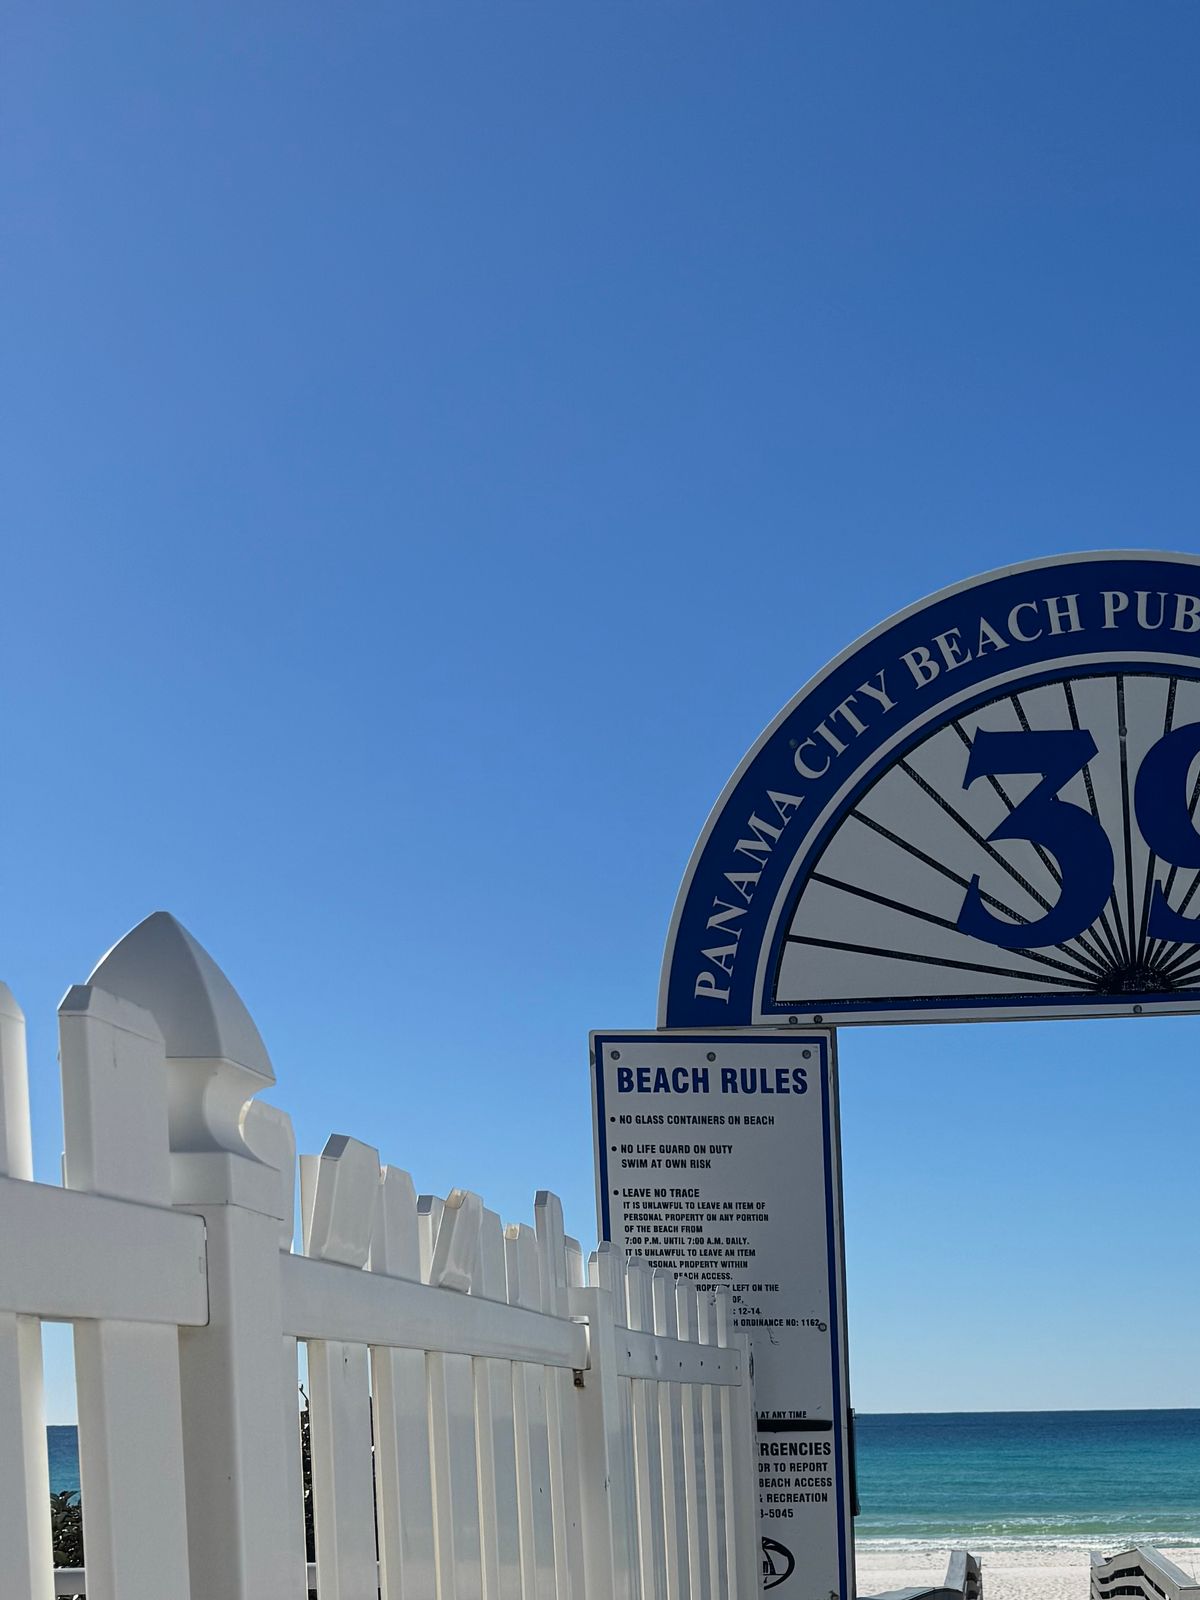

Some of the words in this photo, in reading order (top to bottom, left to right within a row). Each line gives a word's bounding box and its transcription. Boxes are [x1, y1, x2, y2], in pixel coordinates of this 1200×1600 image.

[694, 789, 806, 1004] PANAMA
[793, 669, 899, 779] CITY
[899, 594, 1085, 690] BEACH
[617, 1068, 710, 1094] BEACH
[720, 1068, 808, 1094] RULES
[619, 1116, 632, 1125] NO
[635, 1116, 664, 1125] GLASS
[666, 1116, 726, 1126] CONTAINERS
[728, 1116, 741, 1126] ON
[743, 1116, 775, 1126] BEACH
[620, 1145, 634, 1154] NO
[636, 1145, 656, 1154] LIFE
[659, 1145, 691, 1154] GUARD
[693, 1145, 706, 1154] ON
[709, 1145, 733, 1154] DUTY
[621, 1159, 648, 1169] SWIM
[650, 1159, 662, 1169] AT
[665, 1159, 687, 1169] OWN
[690, 1159, 712, 1169] RISK
[622, 1188, 651, 1198] LEAVE
[654, 1188, 667, 1198] NO
[669, 1188, 700, 1198] TRACE
[623, 1202, 630, 1210] IT
[632, 1202, 641, 1210] IS
[642, 1202, 684, 1210] UNLAWFUL
[685, 1202, 695, 1210] TO
[697, 1202, 721, 1210] LEAVE
[722, 1202, 733, 1210] AN
[735, 1202, 754, 1210] ITEM
[755, 1202, 766, 1210] OF
[623, 1214, 663, 1222] PERSONAL
[664, 1214, 704, 1222] PROPERTY
[706, 1214, 717, 1222] ON
[719, 1214, 734, 1222] ANY
[736, 1214, 769, 1222] PORTION
[624, 1225, 634, 1233] OF
[636, 1225, 651, 1233] THE
[653, 1225, 679, 1233] BEACH
[680, 1225, 703, 1233] FROM
[624, 1237, 642, 1245] 7:00
[644, 1237, 662, 1245] P.M.
[663, 1237, 686, 1245] UNTIL
[687, 1237, 705, 1245] 7:00
[706, 1237, 724, 1245] A.M.
[725, 1237, 750, 1245] DAILY.
[625, 1249, 632, 1257] IT
[634, 1249, 643, 1257] IS
[644, 1249, 686, 1257] UNLAWFUL
[687, 1249, 697, 1257] TO
[699, 1249, 723, 1257] LEAVE
[724, 1249, 735, 1257] AN
[737, 1249, 756, 1257] ITEM
[648, 1260, 678, 1269] RSONAL
[696, 1284, 730, 1292] ROPEY
[732, 1284, 750, 1292] LEFT
[751, 1284, 763, 1292] ON
[764, 1284, 779, 1292] THE
[760, 1411, 770, 1419] AT
[771, 1411, 787, 1419] ANY
[788, 1411, 807, 1419] TIME
[760, 1443, 832, 1456] RGENCIES
[758, 1463, 771, 1473] OR
[773, 1463, 786, 1472] TO
[789, 1462, 828, 1472] REPORT
[758, 1478, 791, 1488] BEACH
[794, 1478, 833, 1487] ACCESS
[766, 1493, 828, 1503] RECREATION
[760, 1509, 794, 1519] -5045
